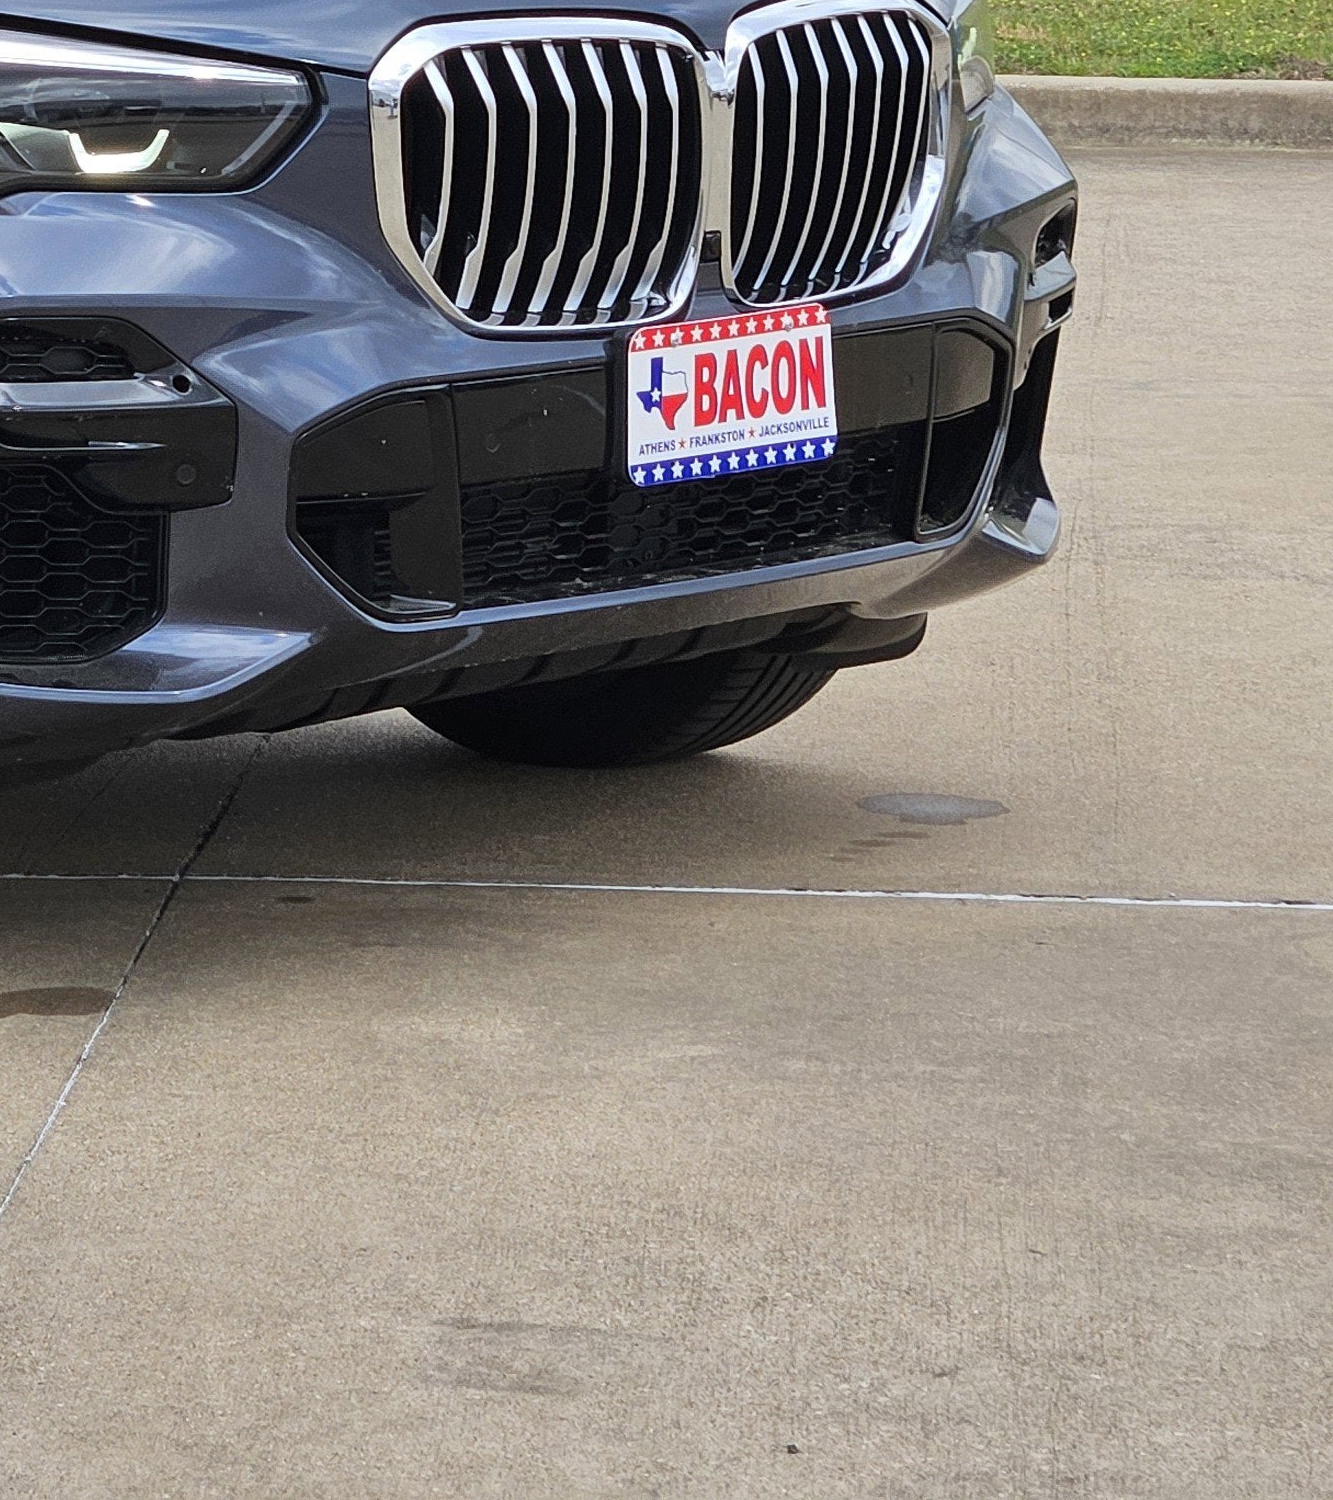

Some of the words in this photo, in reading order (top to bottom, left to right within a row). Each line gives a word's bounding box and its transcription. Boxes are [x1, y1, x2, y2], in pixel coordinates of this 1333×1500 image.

[694, 336, 827, 428] BACON
[639, 439, 676, 457] ATHENS
[689, 429, 746, 449] FRANKSTON
[758, 416, 830, 438] JACKSONVILLE
